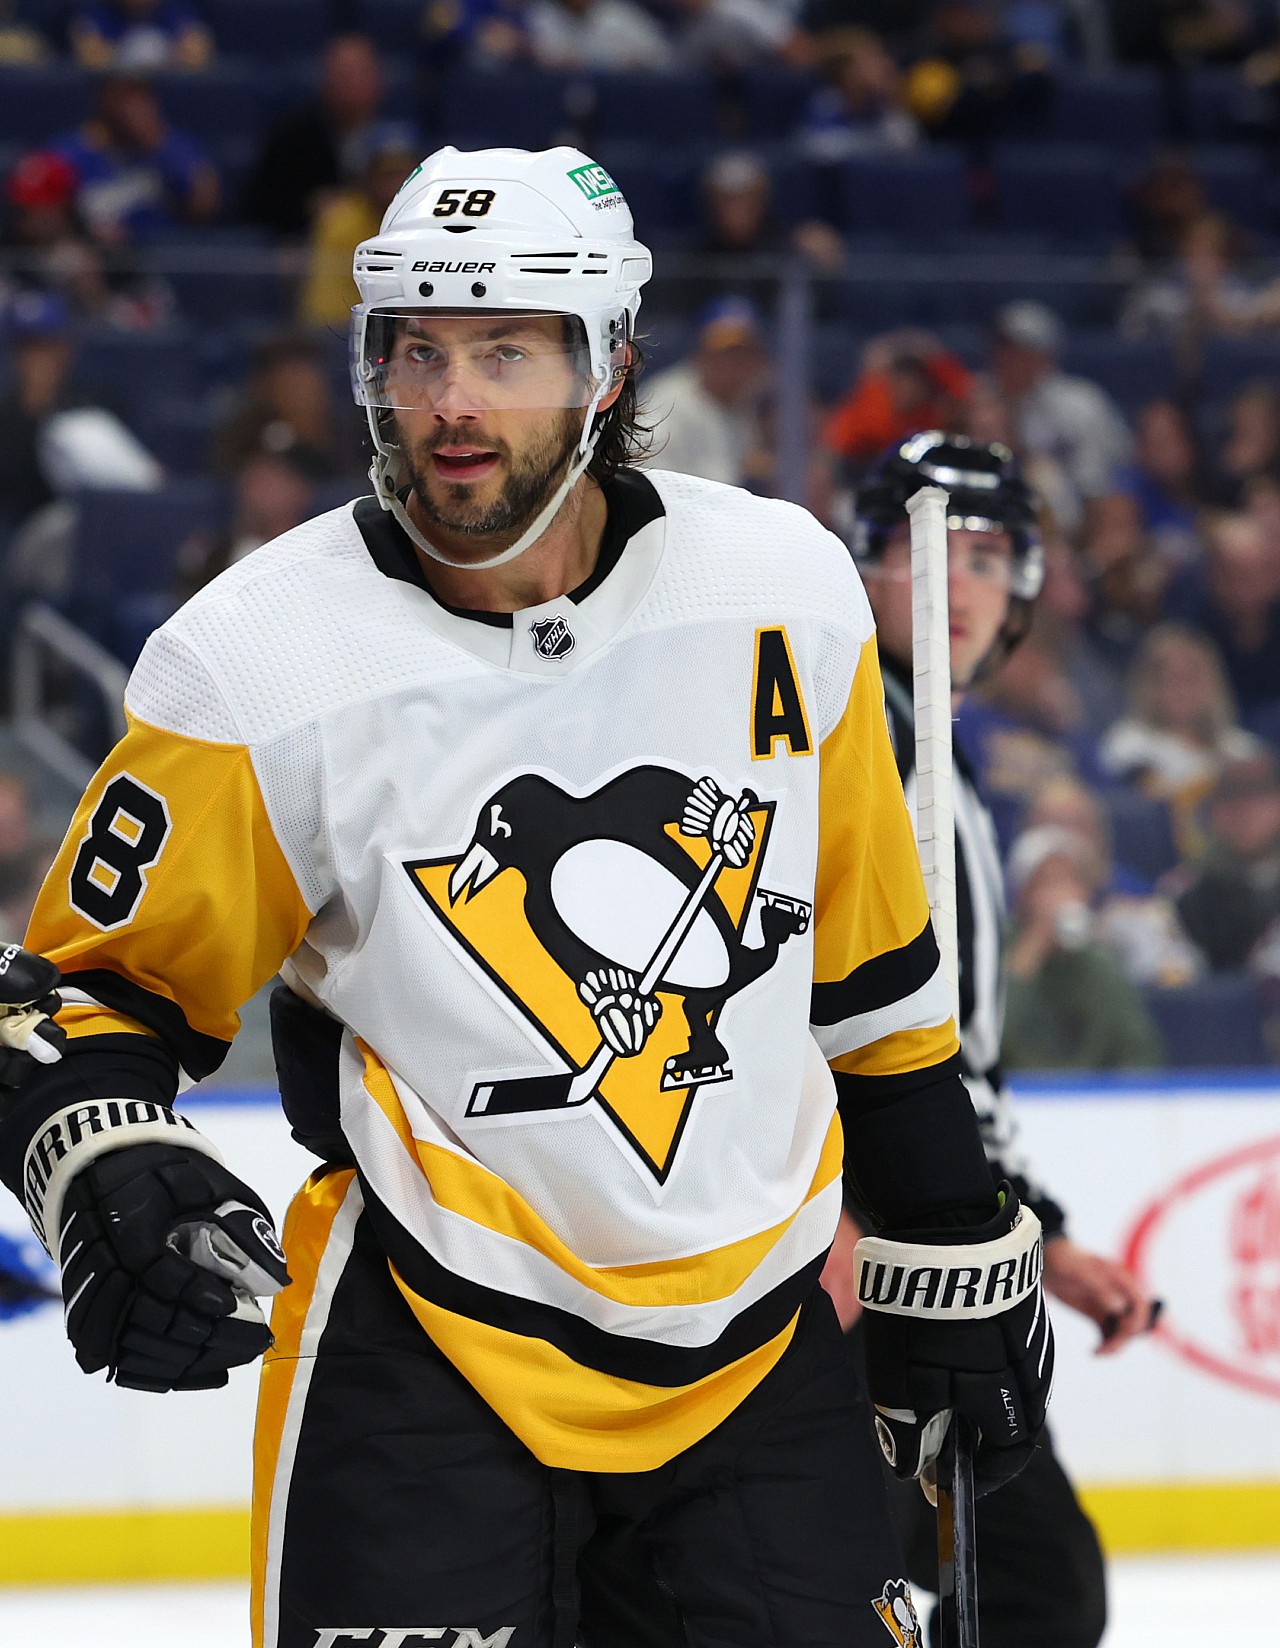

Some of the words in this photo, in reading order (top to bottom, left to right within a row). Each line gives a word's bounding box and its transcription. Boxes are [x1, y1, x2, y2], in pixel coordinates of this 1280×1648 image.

[431, 188, 497, 218] 58
[544, 625, 564, 655] NHL
[750, 624, 814, 761] A
[68, 769, 173, 933] 8
